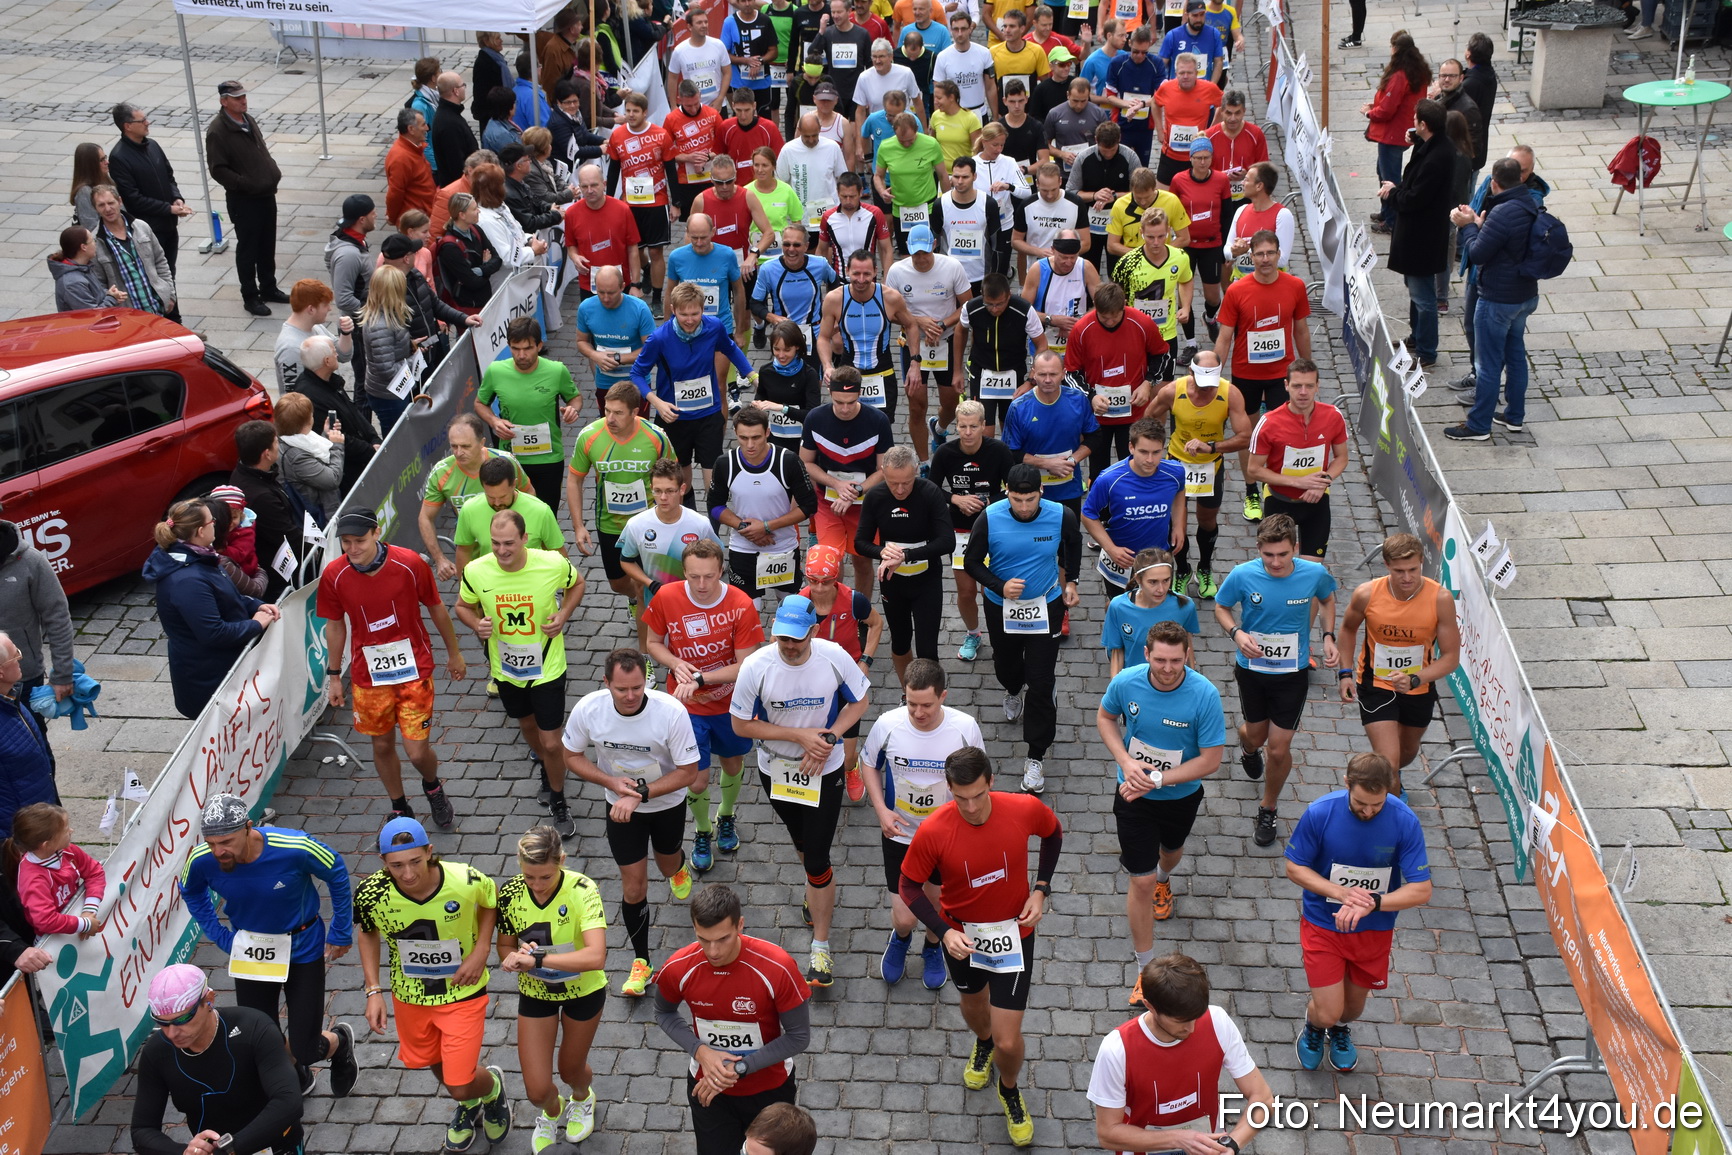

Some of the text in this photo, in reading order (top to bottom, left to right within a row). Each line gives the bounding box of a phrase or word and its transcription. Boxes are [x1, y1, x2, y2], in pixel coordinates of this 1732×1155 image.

[247, 1, 265, 9] um
[267, 0, 286, 10] frei
[289, 2, 302, 11] zu
[304, 3, 333, 13] sein.
[1178, 40, 1187, 50] 3
[835, 51, 854, 59] 2737
[634, 185, 644, 194] 57
[903, 212, 925, 221] 2580
[954, 238, 977, 249] 2051
[1360, 253, 1373, 269] swn
[1253, 339, 1281, 351] 2469
[929, 350, 936, 359] 6
[395, 376, 407, 393] swn
[986, 377, 1012, 388] 2714
[1410, 375, 1424, 392] swn
[681, 387, 707, 400] 2928
[861, 385, 881, 396] 705
[523, 434, 538, 445] 55
[595, 460, 651, 473] BOCK
[1292, 457, 1316, 468] 402
[1186, 472, 1207, 484] 415
[611, 491, 639, 503] 2721
[1125, 504, 1168, 517] SYSCAD
[31, 511, 49, 526] BMW
[1477, 539, 1488, 554] sw
[279, 556, 289, 573] swn
[765, 562, 788, 574] 406
[1495, 560, 1512, 581] swn
[757, 576, 784, 587] FELIX
[495, 593, 533, 603] Müller
[1287, 598, 1309, 606] BOCK
[506, 611, 527, 627] M
[1009, 607, 1042, 620] 2652
[373, 653, 407, 671] 2315
[502, 652, 535, 667] 2372
[1386, 657, 1412, 668] 105
[1162, 718, 1189, 729] BOCK
[783, 771, 810, 786] 149
[786, 787, 805, 796] Markus
[907, 792, 934, 808] 146
[981, 873, 996, 884] DEHN
[973, 936, 1013, 954] 2269
[244, 947, 276, 962] 405
[408, 951, 452, 966] 2669
[1594, 948, 1603, 963] die
[707, 1033, 753, 1049] 2584
[1169, 1100, 1188, 1110] DEHN
